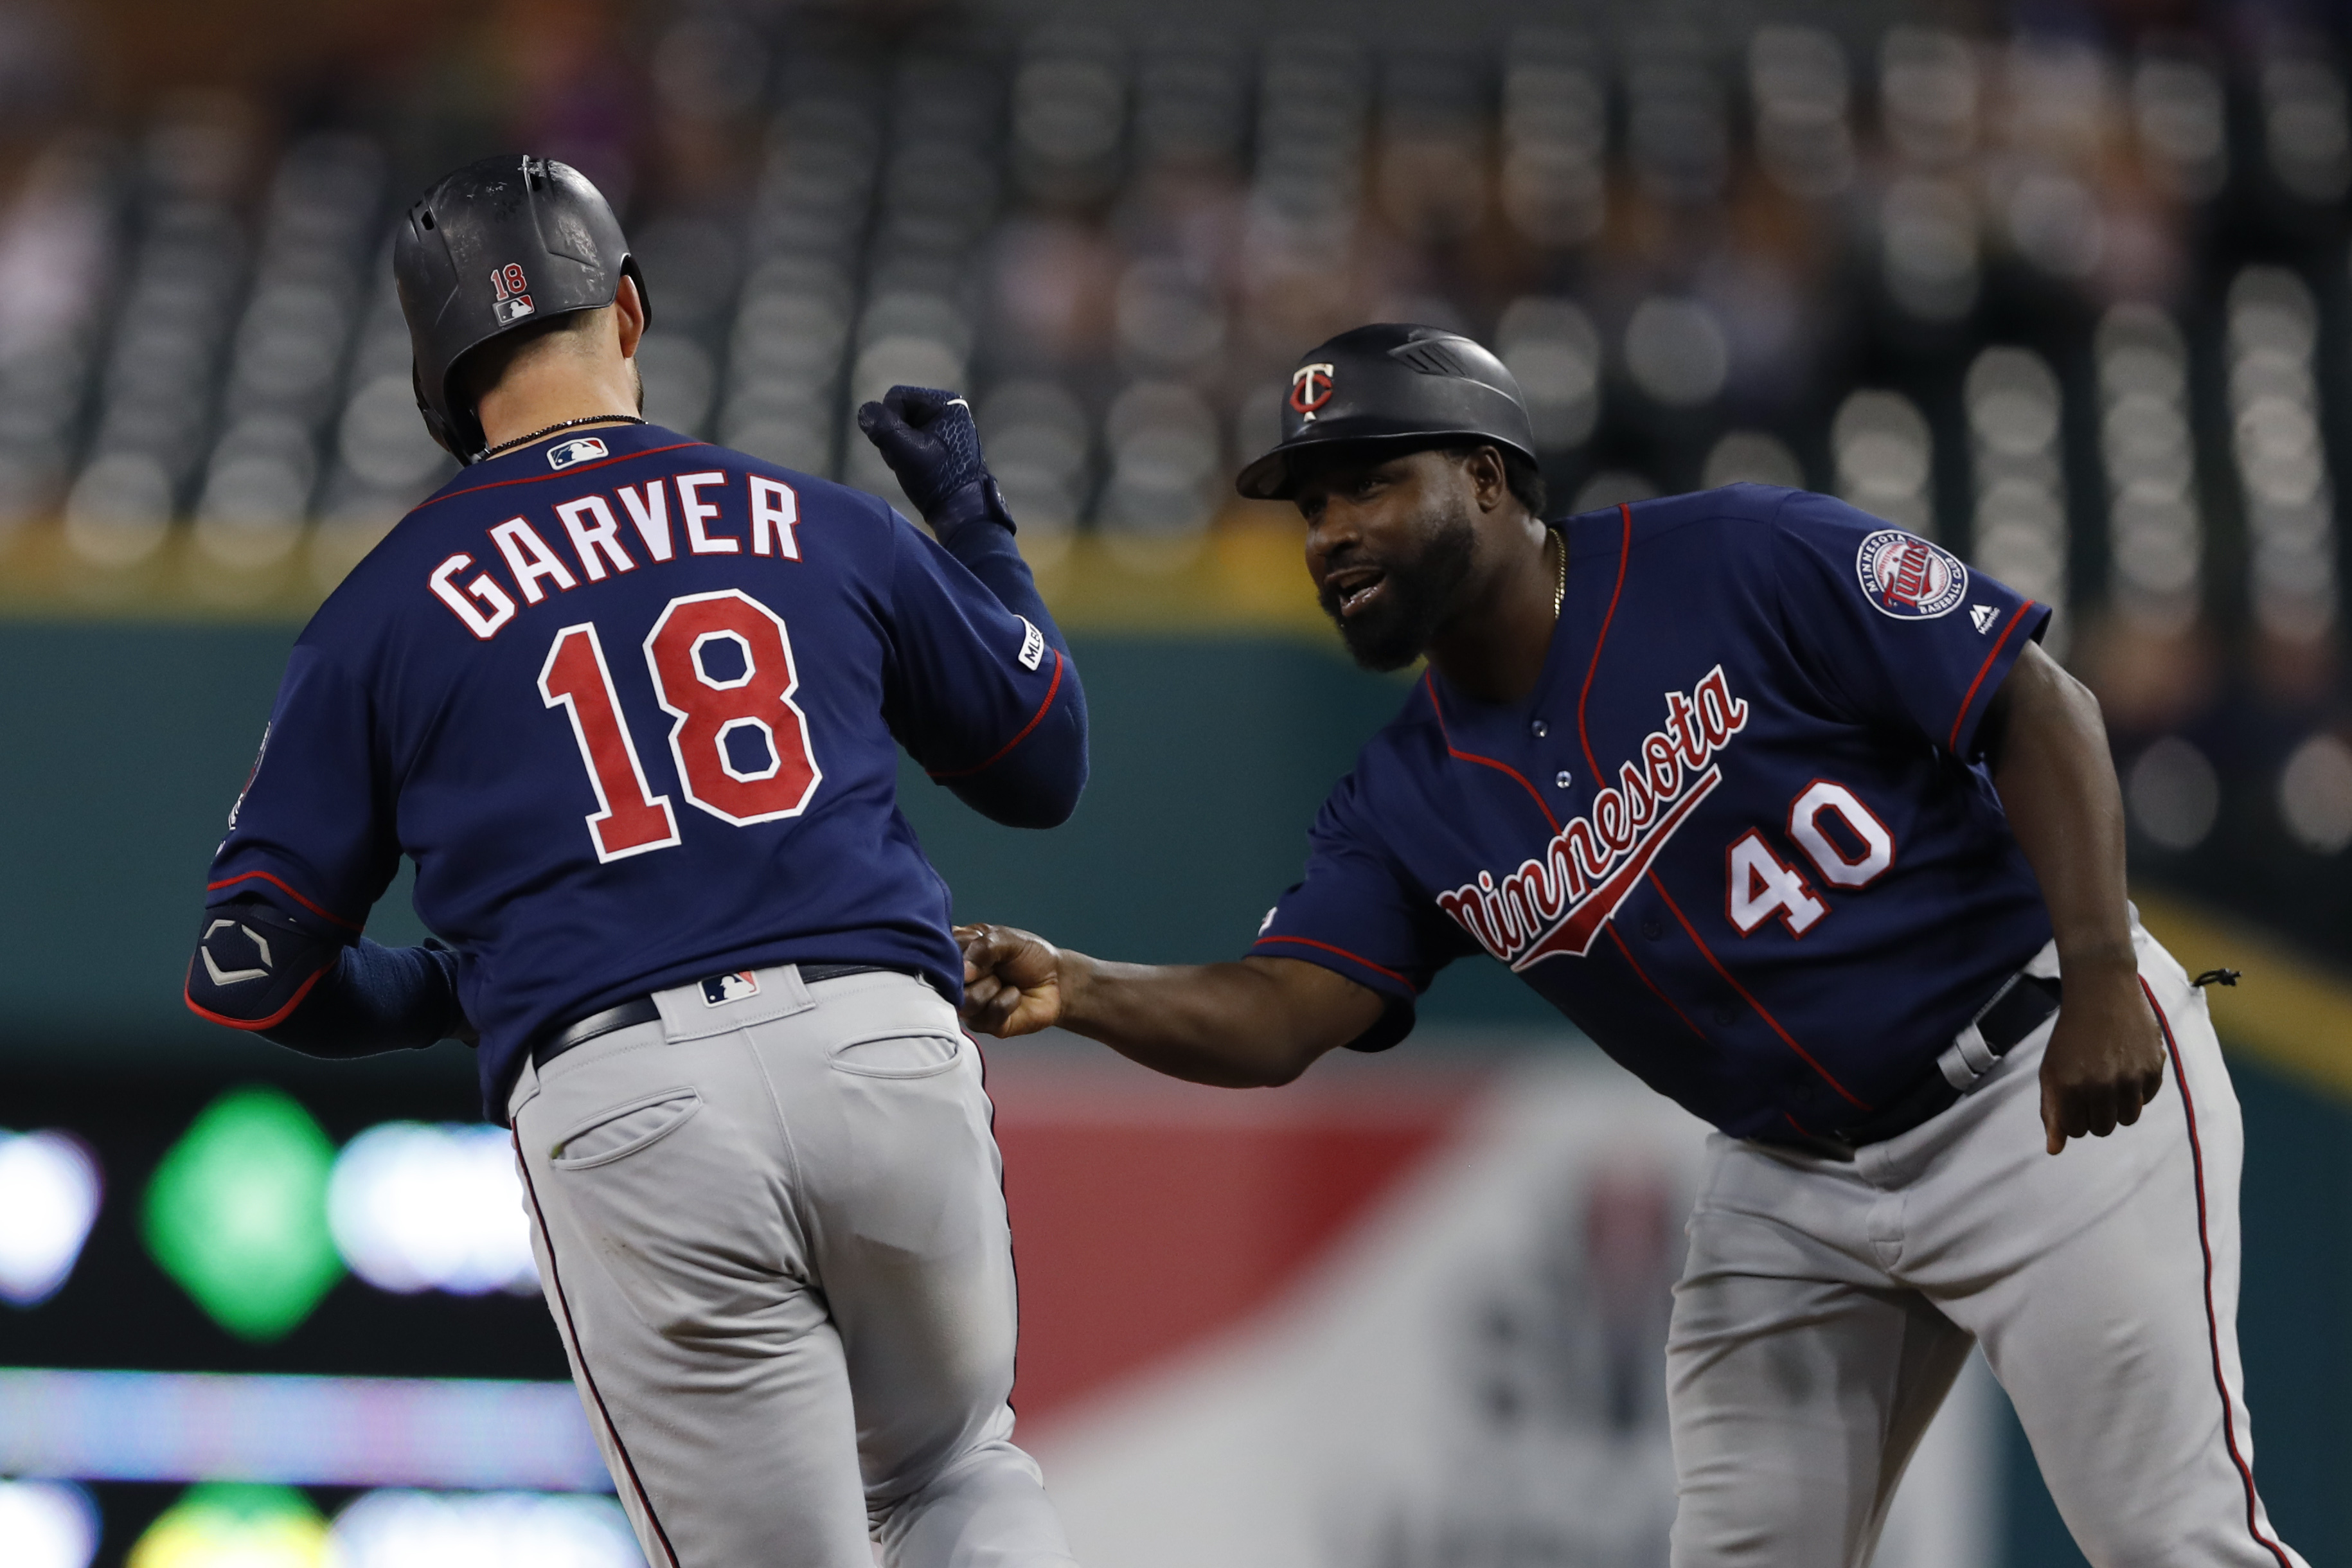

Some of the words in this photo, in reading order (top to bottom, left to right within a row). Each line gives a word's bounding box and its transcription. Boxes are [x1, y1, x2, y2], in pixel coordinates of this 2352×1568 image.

[490, 263, 527, 301] 18
[426, 469, 802, 640] GARVER
[1862, 534, 1906, 593] MINNESOTA
[1883, 540, 1930, 608] Twins
[1920, 582, 1962, 614] BASEBALL
[537, 588, 823, 864] 18
[1724, 778, 1895, 940] 40
